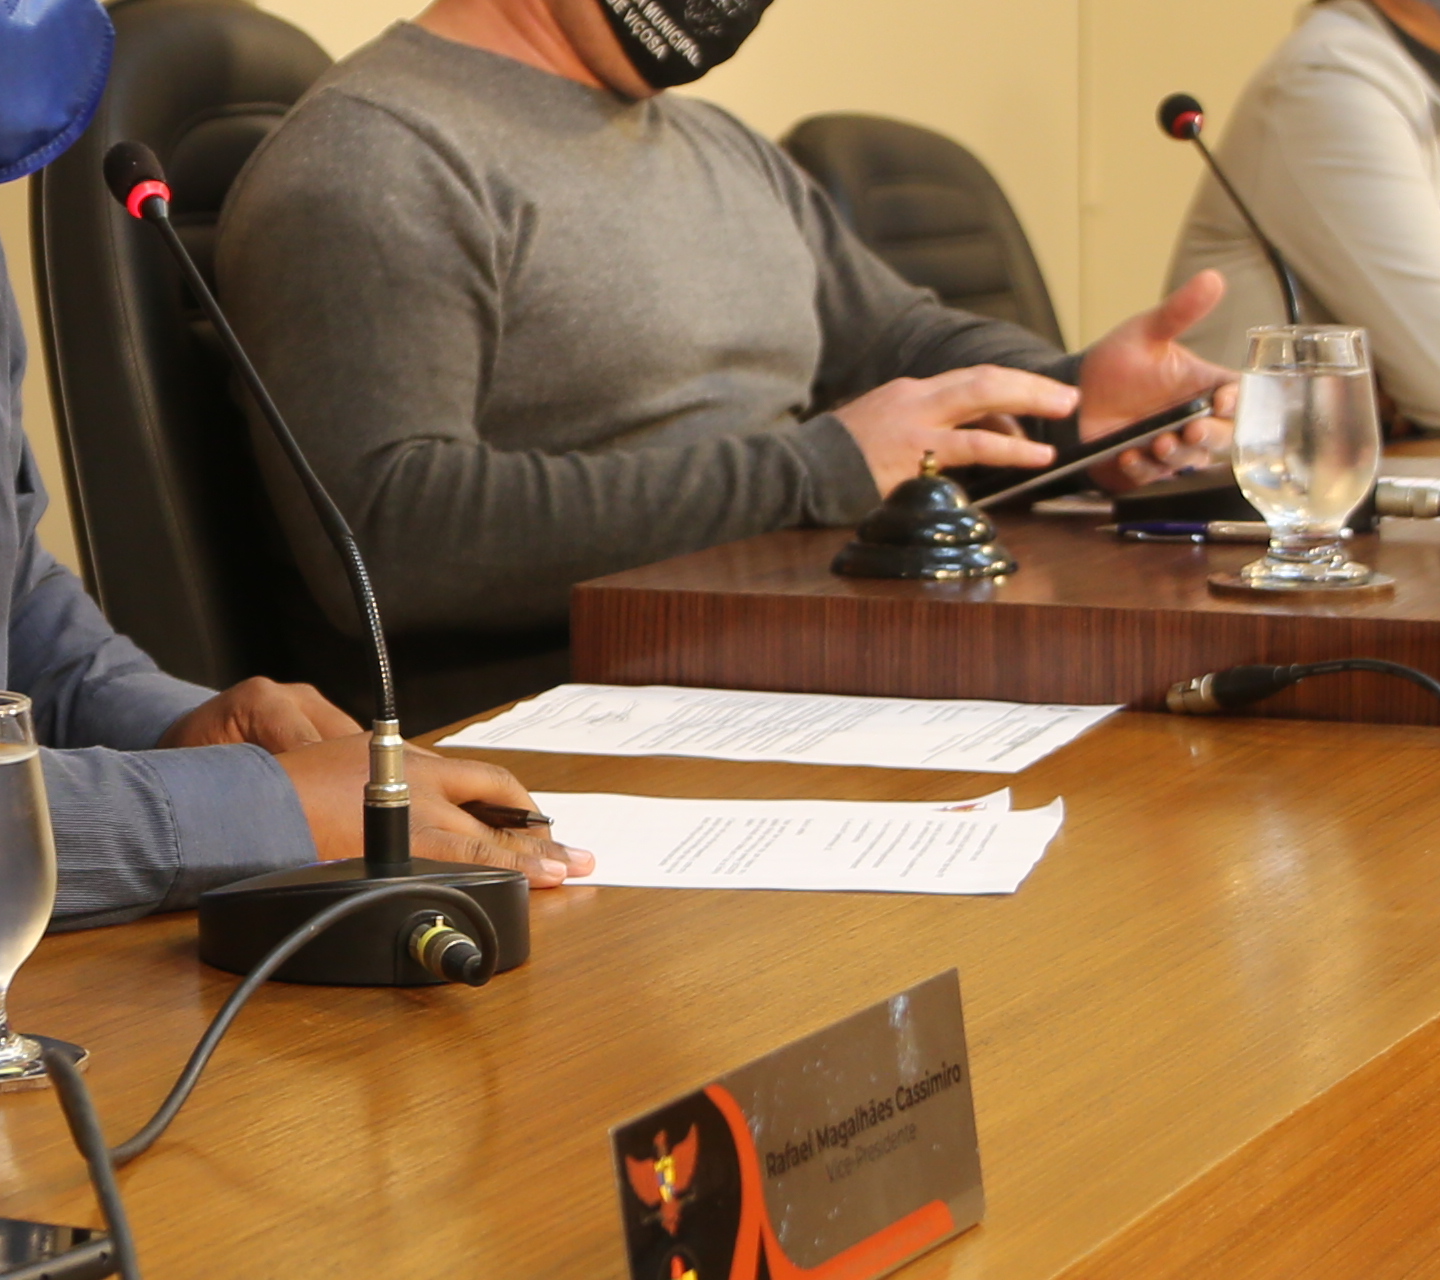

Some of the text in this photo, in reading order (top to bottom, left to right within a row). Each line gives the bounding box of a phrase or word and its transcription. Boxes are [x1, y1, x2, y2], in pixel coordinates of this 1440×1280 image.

[624, 7, 669, 59] VIÇOSA
[643, 1, 701, 67] MUNICIPAL
[765, 1061, 962, 1179] Rafael Magalhães Cassimiro
